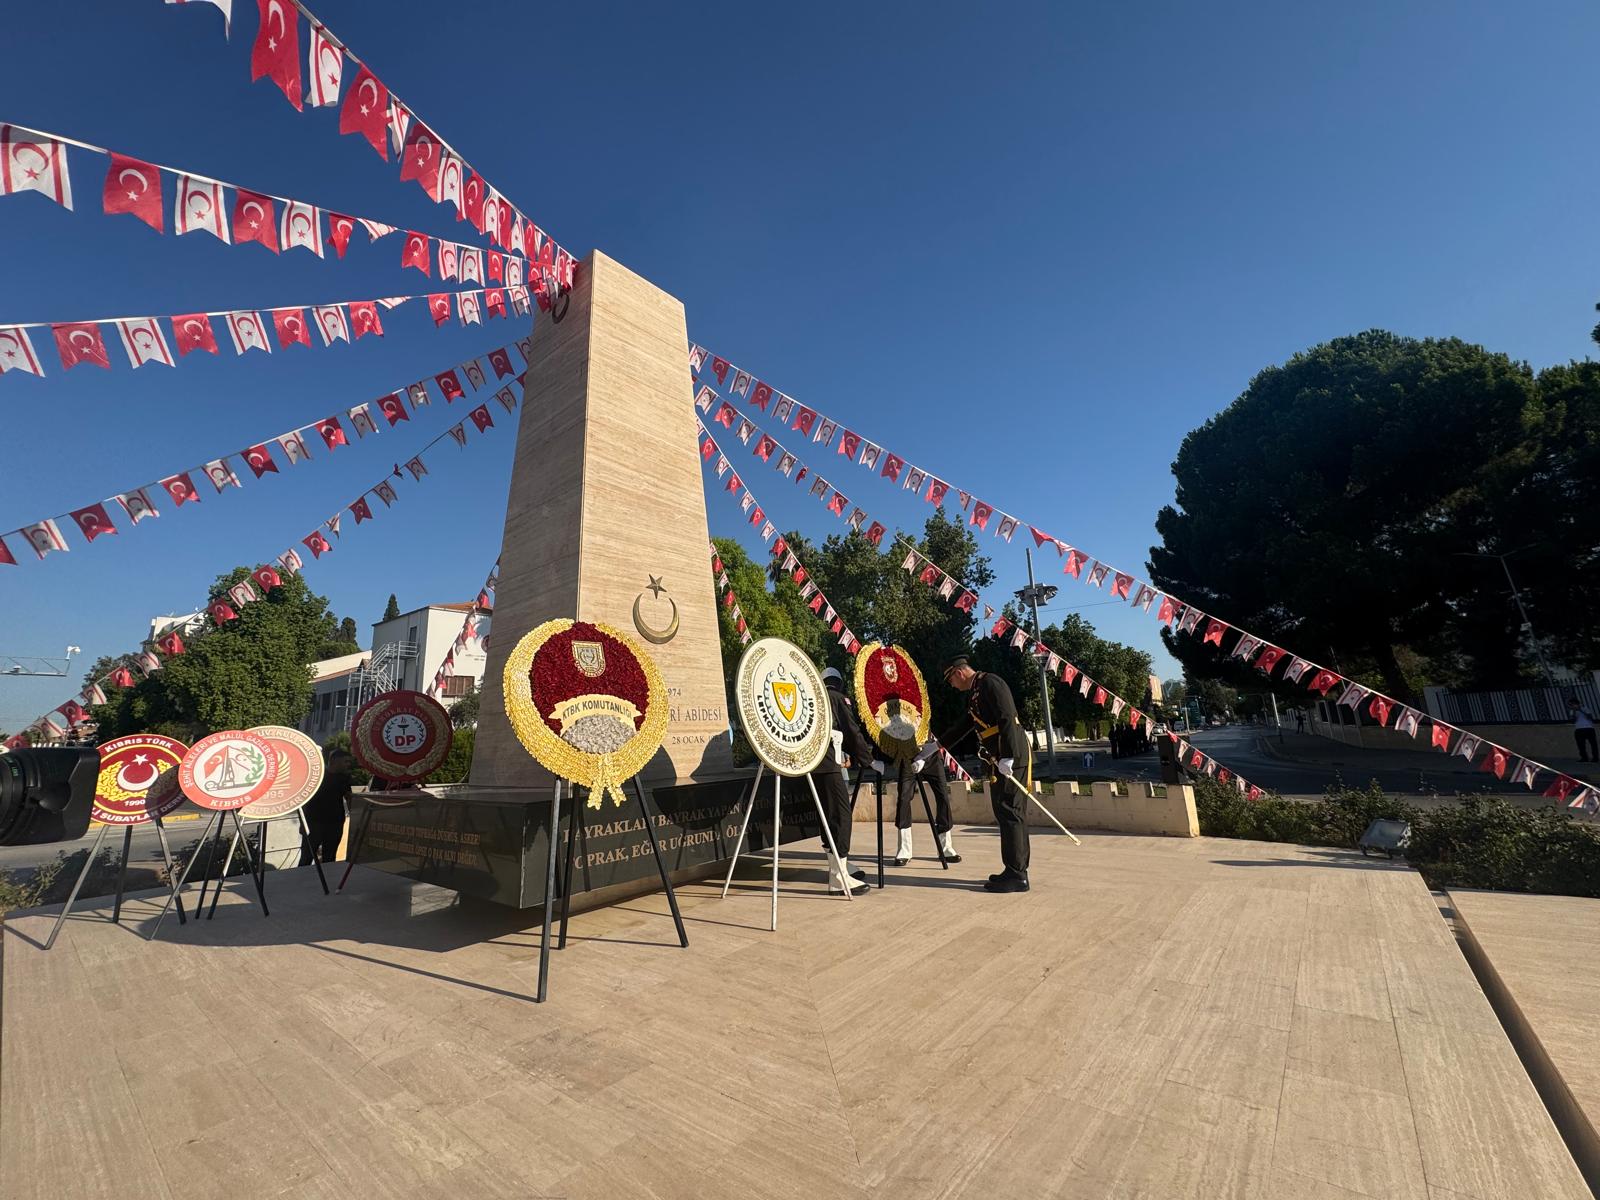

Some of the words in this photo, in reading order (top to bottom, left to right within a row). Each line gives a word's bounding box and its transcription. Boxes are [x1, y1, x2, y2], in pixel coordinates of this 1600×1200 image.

[667, 688, 681, 697] 974
[562, 703, 581, 720] KTBK
[685, 706, 721, 721] ABİDESİ
[104, 737, 143, 753] KIBRIS
[146, 737, 173, 749] TÜRK
[207, 735, 218, 745] VE
[394, 735, 416, 747] DP
[672, 736, 681, 745] 28
[682, 735, 705, 744] OCAK
[124, 799, 146, 808] 1990
[210, 795, 252, 808] KIBRIS
[567, 847, 630, 870] OPRAK,
